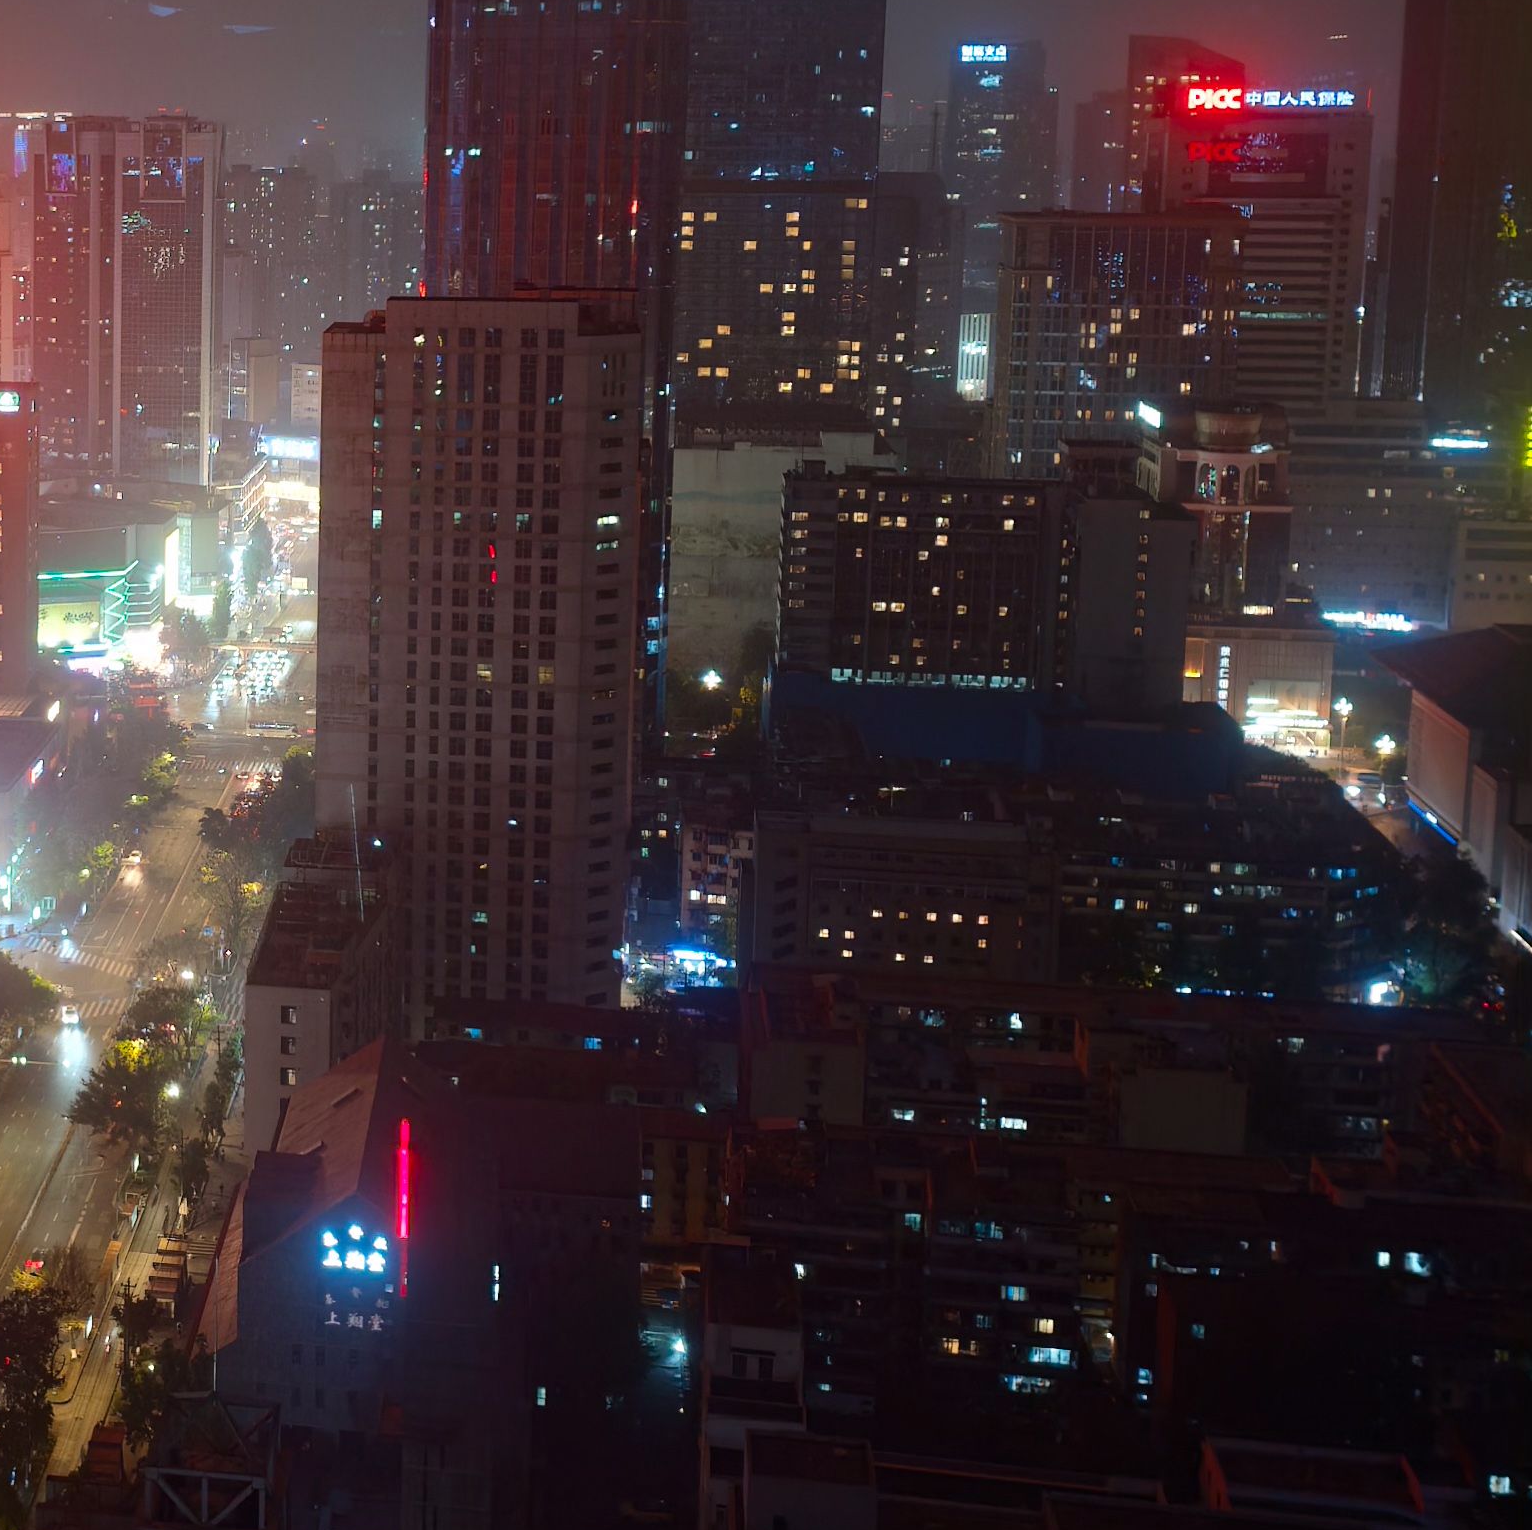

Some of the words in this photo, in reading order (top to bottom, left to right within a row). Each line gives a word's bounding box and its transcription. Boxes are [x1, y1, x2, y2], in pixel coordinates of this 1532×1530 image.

[1188, 88, 1242, 109] PICC
[1245, 91, 1355, 107] 中国人民保险
